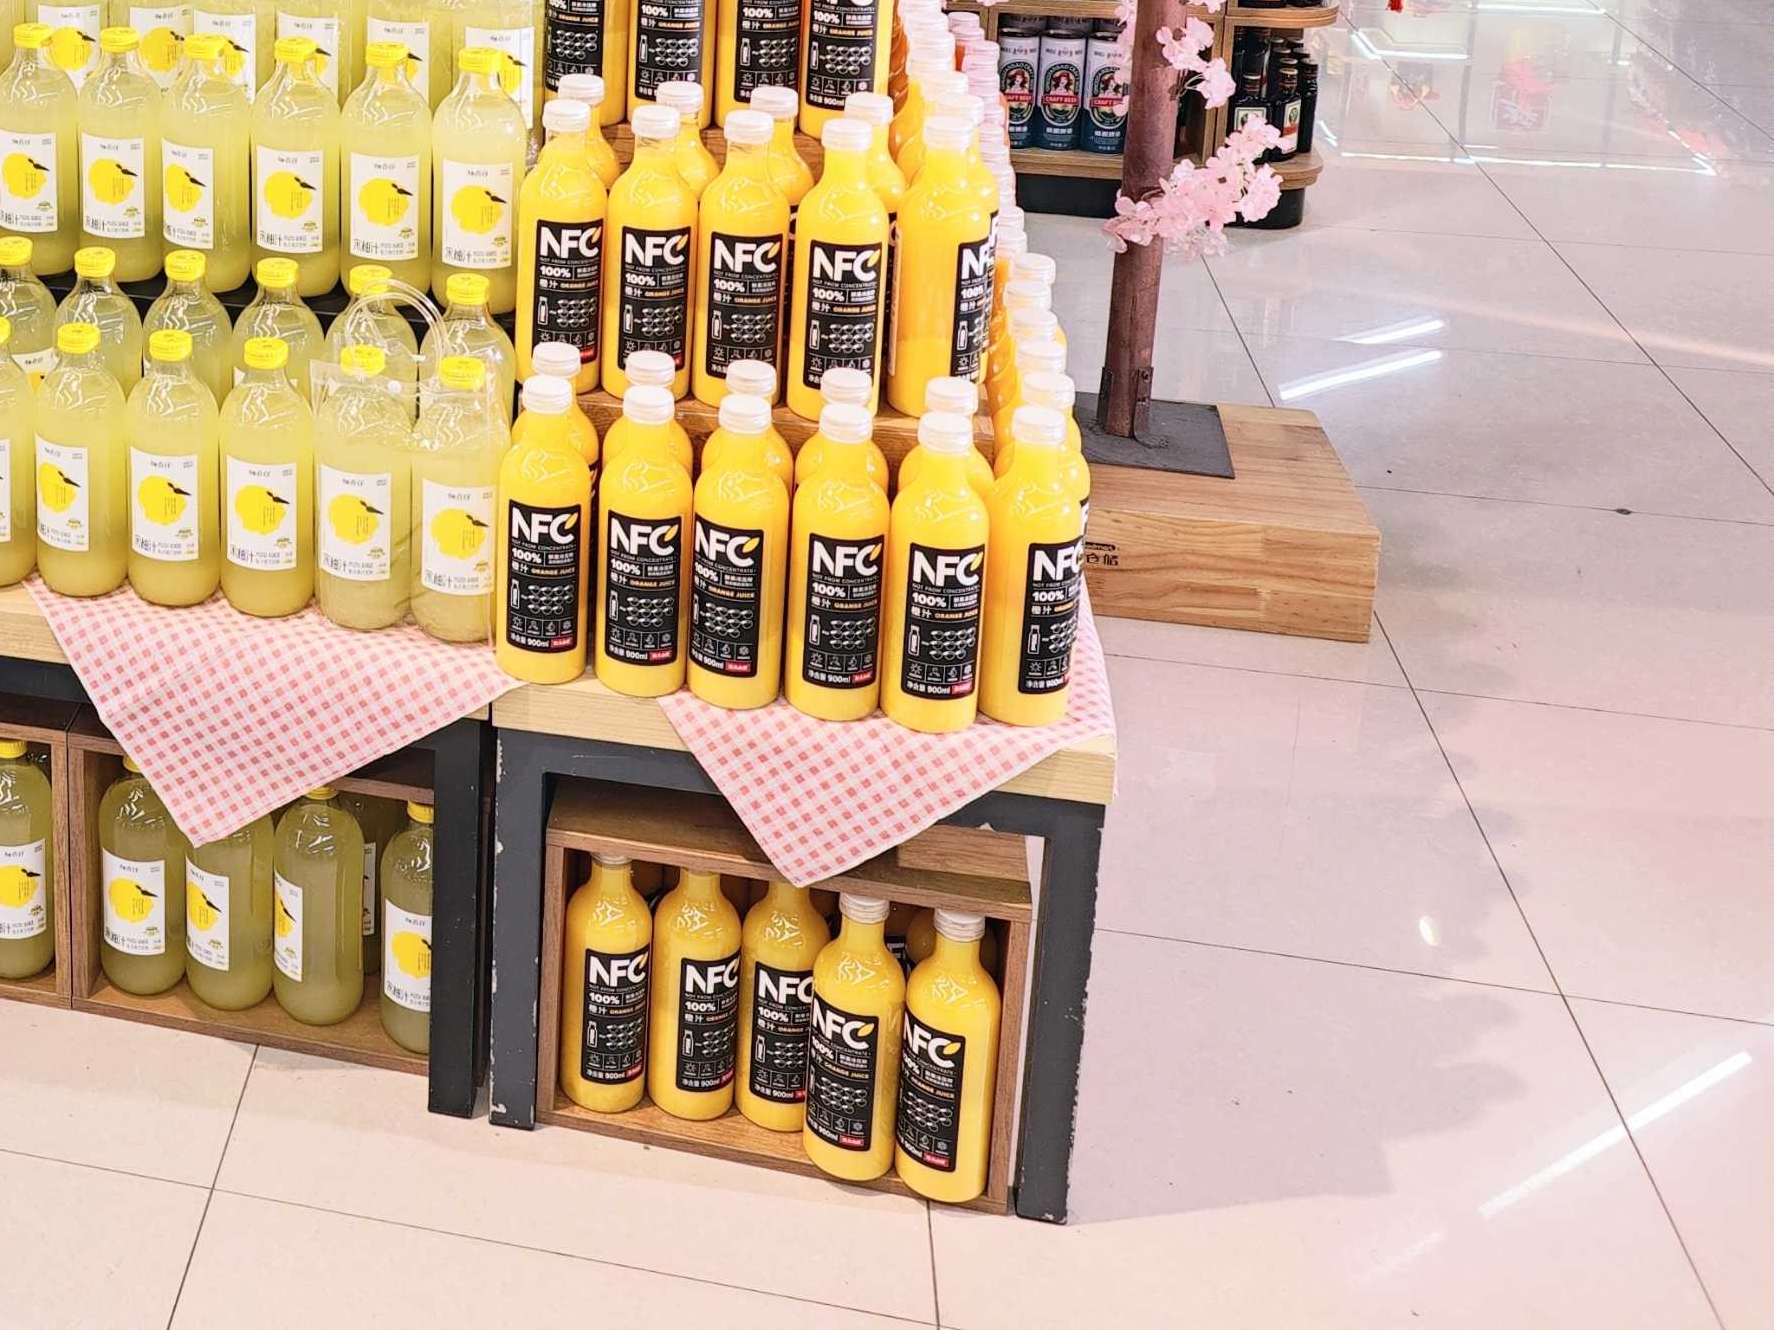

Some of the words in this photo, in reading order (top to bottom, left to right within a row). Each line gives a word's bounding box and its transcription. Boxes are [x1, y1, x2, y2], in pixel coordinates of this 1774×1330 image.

[641, 4, 668, 18] 100%
[742, 7, 774, 19] 100%
[813, 11, 840, 25] 100%
[539, 226, 600, 260] NFC
[625, 233, 688, 268] NFC
[714, 238, 779, 272] NFC
[539, 265, 572, 279] 100%
[814, 247, 879, 281] NFC
[624, 273, 656, 287] 100%
[713, 280, 745, 293] 100%
[812, 288, 845, 302] 100%
[512, 507, 577, 544] NFC
[610, 518, 676, 556] NFC
[695, 520, 757, 567] NFC
[512, 548, 541, 564] 100%
[813, 541, 879, 577] NFC
[610, 558, 641, 576] 100%
[695, 562, 718, 581] 100%
[912, 550, 981, 587] NFC
[812, 582, 846, 598] 100%
[1032, 590, 1064, 602] 100%
[912, 592, 947, 608] 100%
[527, 637, 549, 648] 900ml
[927, 684, 950, 694] 900ml
[590, 952, 647, 987] NFC
[685, 957, 739, 994] NFC
[589, 992, 620, 1004] 100%
[684, 1001, 716, 1012] 100%
[758, 1006, 789, 1021] 100%
[812, 998, 872, 1050] NFC
[812, 1035, 835, 1060] 100%
[903, 1012, 957, 1069] NFC
